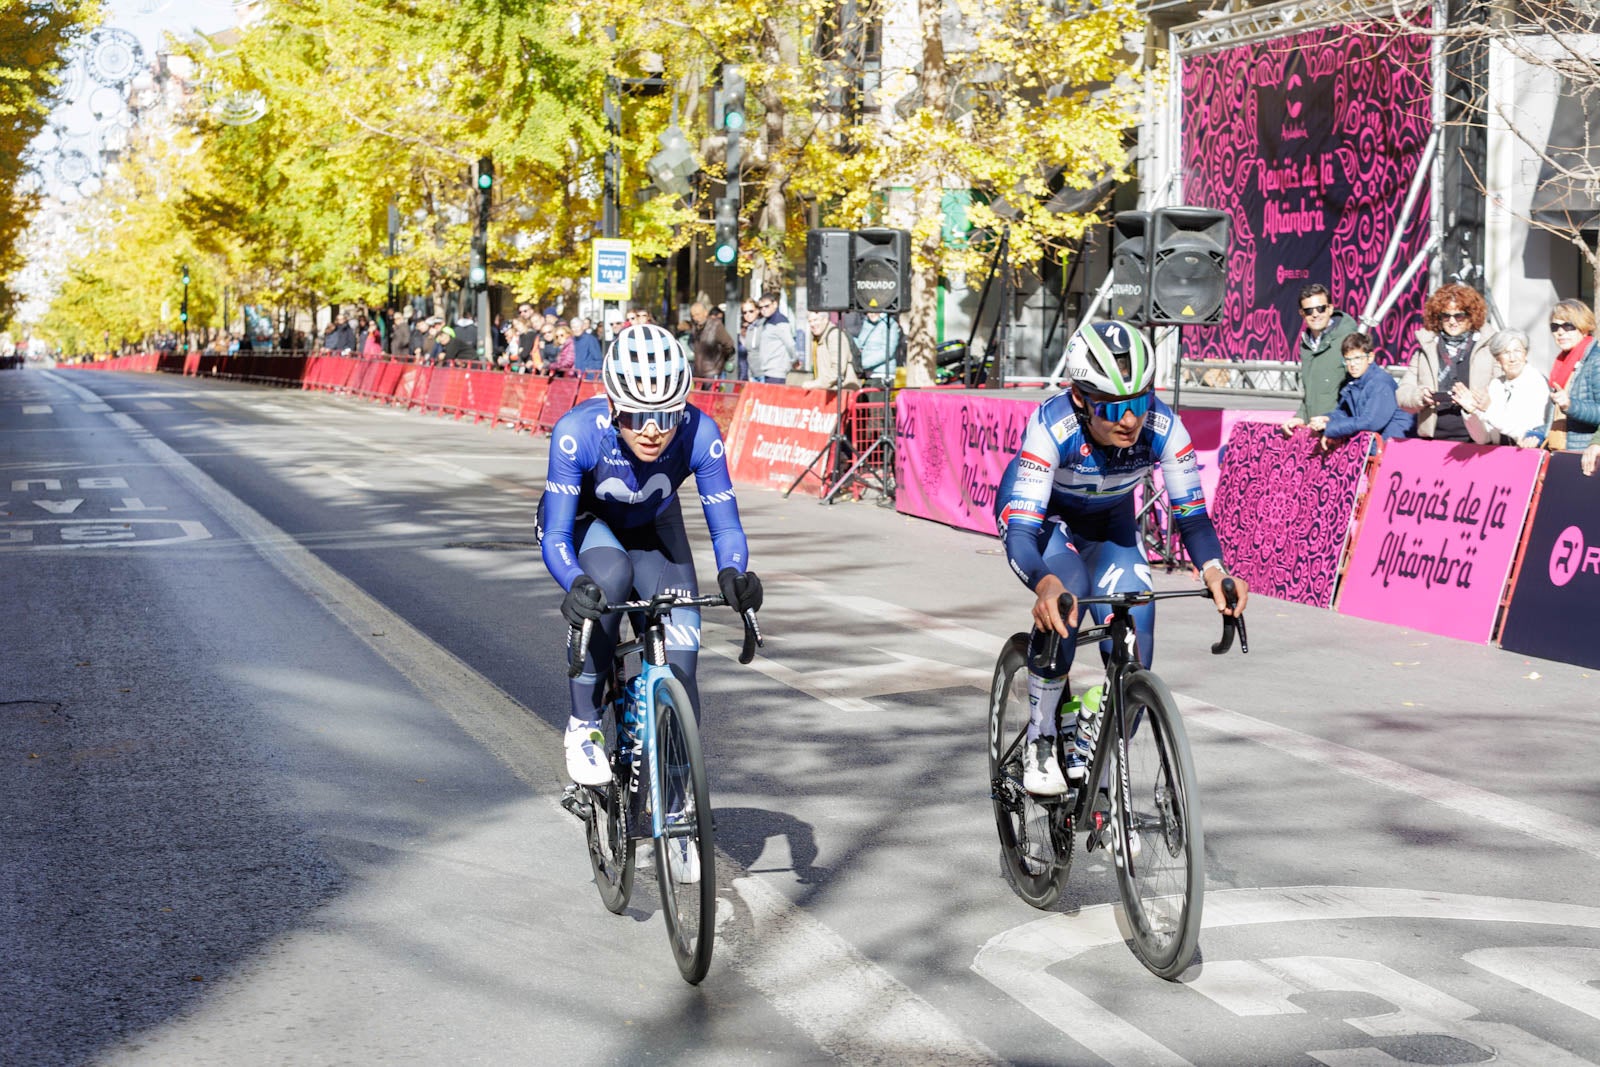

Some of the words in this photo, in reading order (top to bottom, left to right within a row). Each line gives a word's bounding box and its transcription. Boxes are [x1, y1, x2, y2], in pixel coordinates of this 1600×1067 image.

[1302, 154, 1319, 187] de
[856, 280, 897, 291] TORNADO
[1003, 413, 1018, 455] de
[1018, 459, 1050, 473] OUDAL
[699, 487, 735, 505] CANY
[1452, 481, 1482, 525] de
